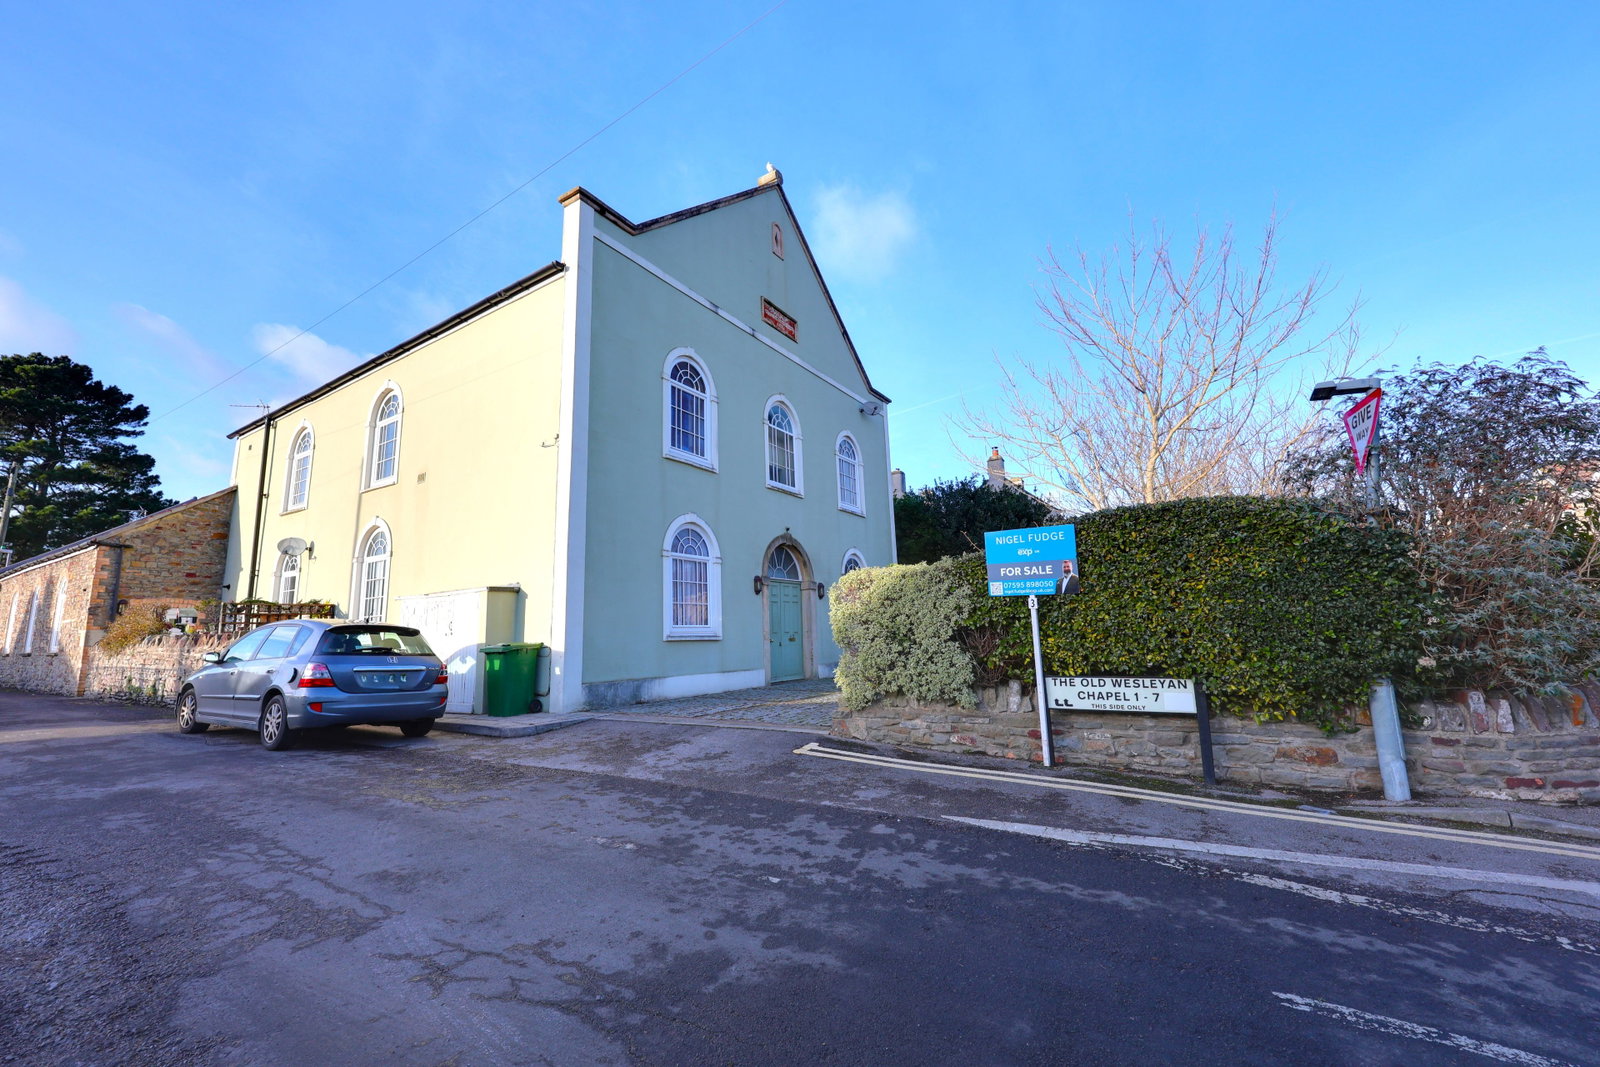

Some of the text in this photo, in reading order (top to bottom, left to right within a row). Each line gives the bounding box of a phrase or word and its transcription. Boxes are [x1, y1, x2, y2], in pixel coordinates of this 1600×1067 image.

[1351, 404, 1371, 429] GIVE
[1355, 426, 1369, 441] WAY
[995, 531, 1065, 544] NIGEL FUDGE
[1017, 548, 1033, 556] exp
[1000, 565, 1053, 576] FOR SALE
[1030, 598, 1035, 607] 3
[1051, 678, 1188, 689] THE OLD WESLEYAN
[1077, 691, 1130, 701] CHAPEL
[1134, 692, 1139, 702] 1
[1152, 692, 1160, 702] 7
